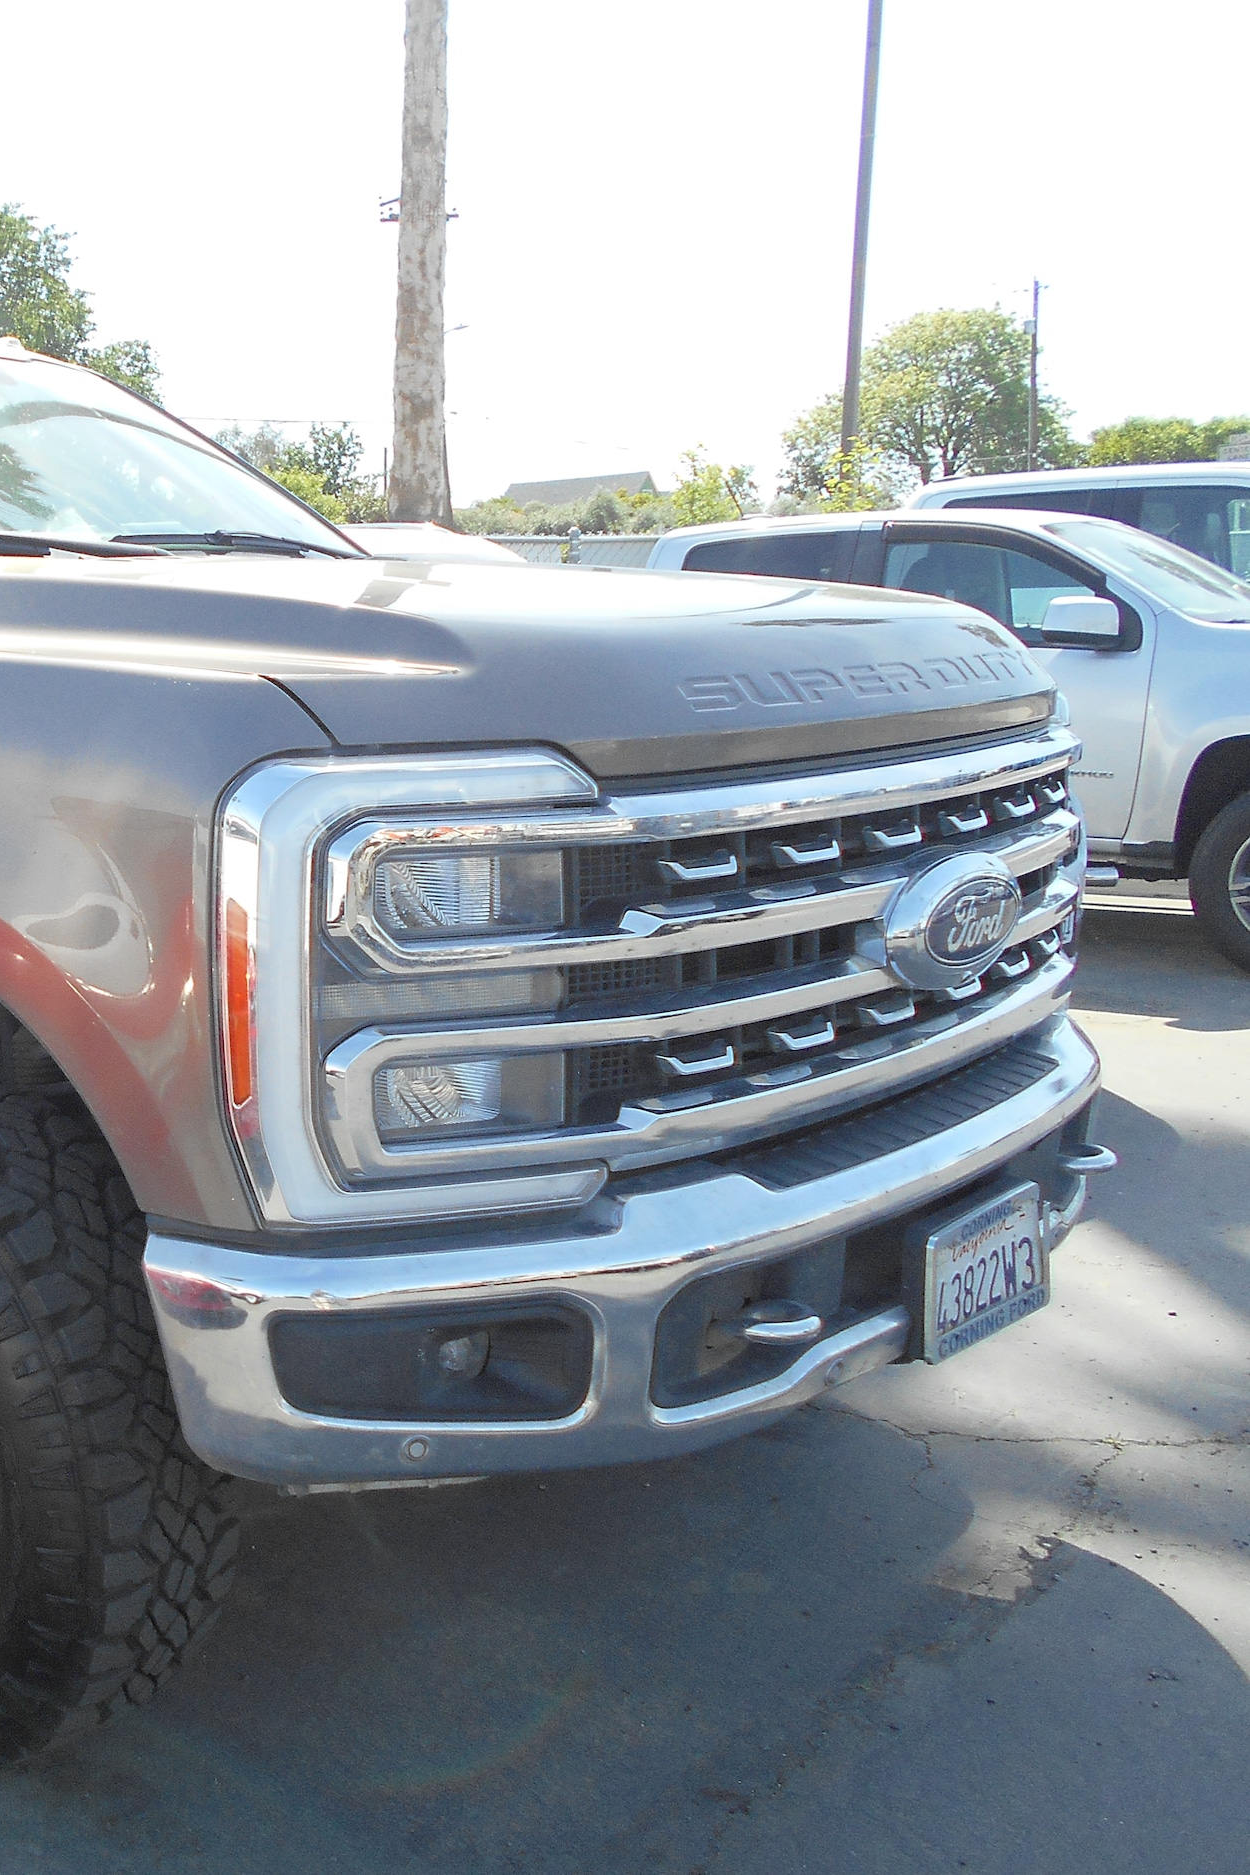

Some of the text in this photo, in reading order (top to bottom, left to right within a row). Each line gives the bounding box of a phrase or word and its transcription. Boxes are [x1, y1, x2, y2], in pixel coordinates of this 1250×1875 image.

[677, 650, 1034, 713] SUPER DUTY
[947, 886, 1006, 953] Ford
[936, 1236, 1036, 1333] 43822W3
[938, 1288, 1045, 1358] CORNING FORD
